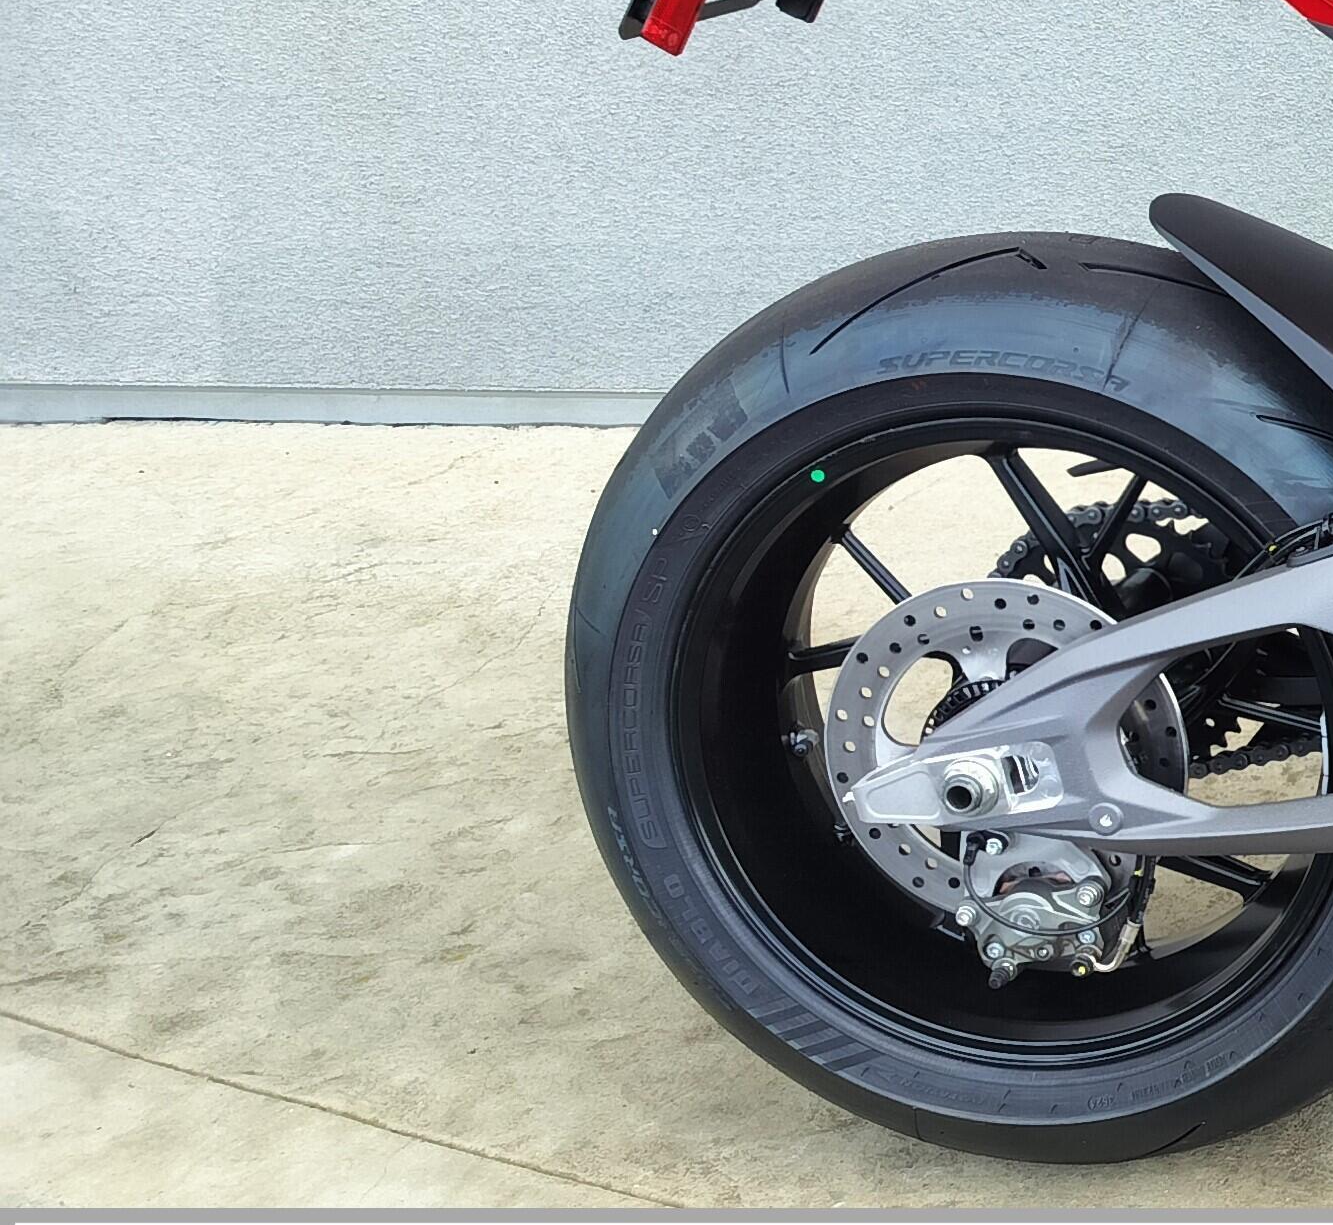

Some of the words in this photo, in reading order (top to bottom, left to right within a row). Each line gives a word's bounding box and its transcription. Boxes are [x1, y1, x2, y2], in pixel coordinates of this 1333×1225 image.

[877, 350, 1131, 392] SUPERCORSA
[621, 622, 656, 840] SUPERCORSA
[650, 557, 670, 605] SP
[663, 873, 766, 996] DIABLO
